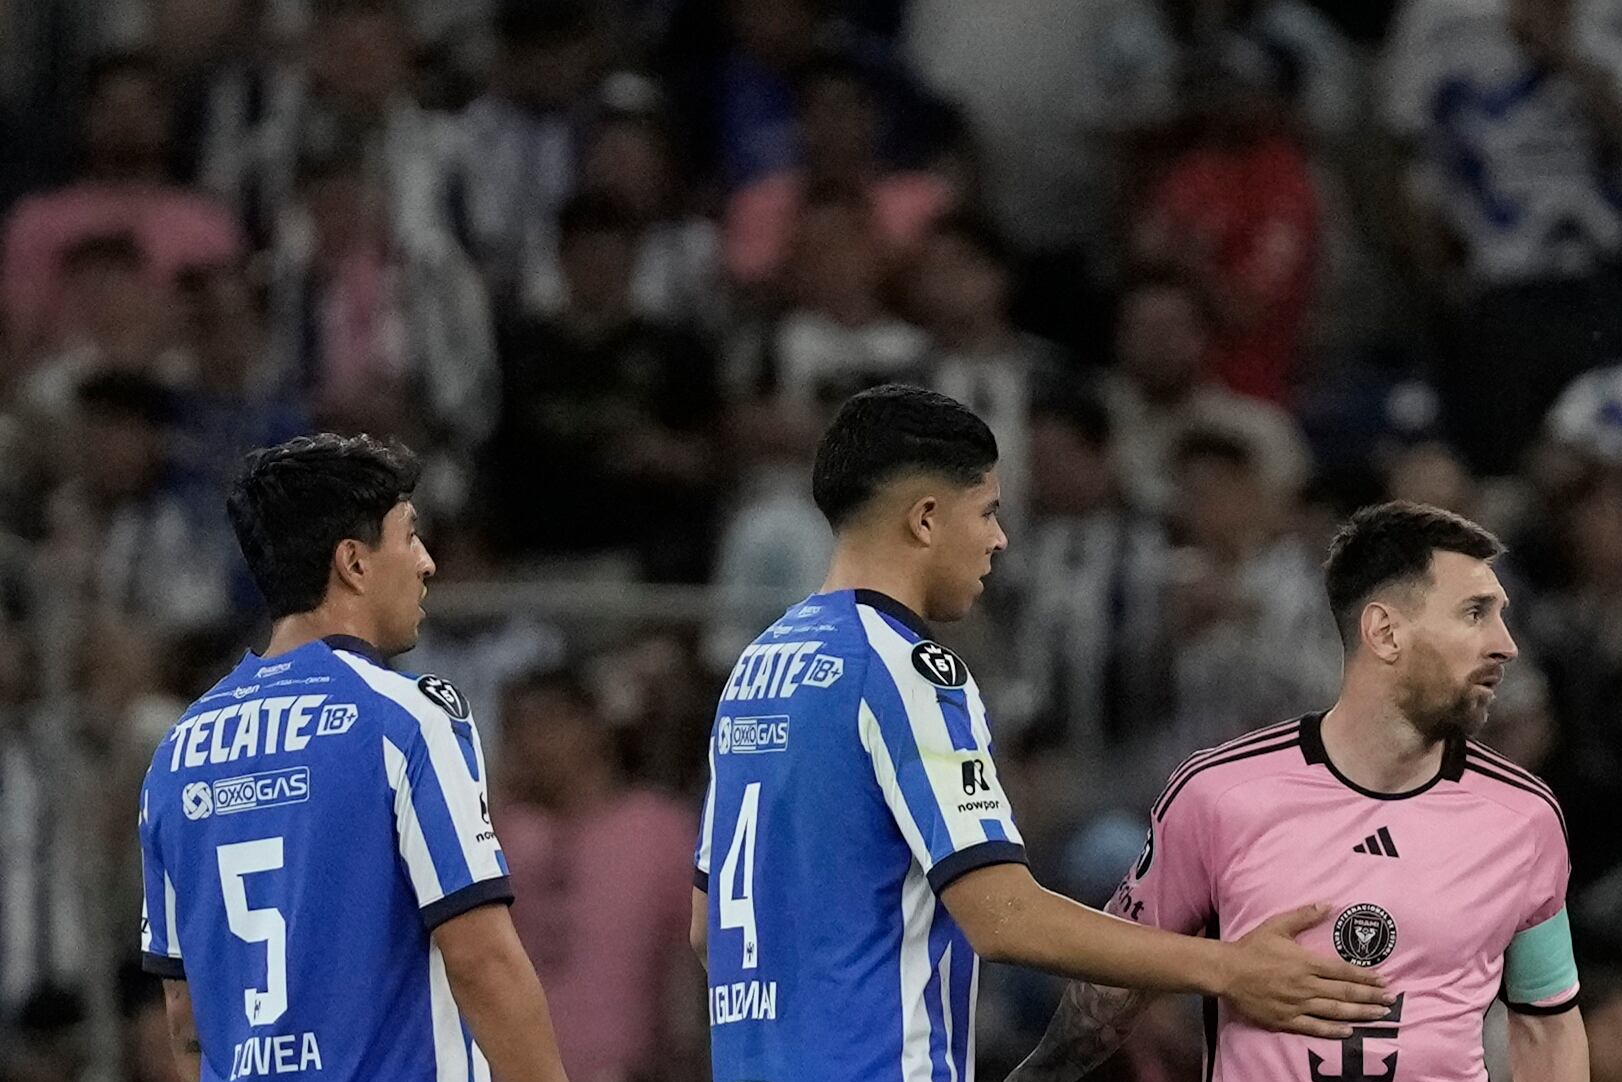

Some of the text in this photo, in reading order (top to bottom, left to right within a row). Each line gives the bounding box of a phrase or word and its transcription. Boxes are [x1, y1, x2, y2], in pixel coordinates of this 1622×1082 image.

[170, 694, 357, 772] TECATE 18+
[719, 641, 841, 701] ECATE 18+
[217, 836, 288, 1028] 5
[720, 782, 761, 968] 4
